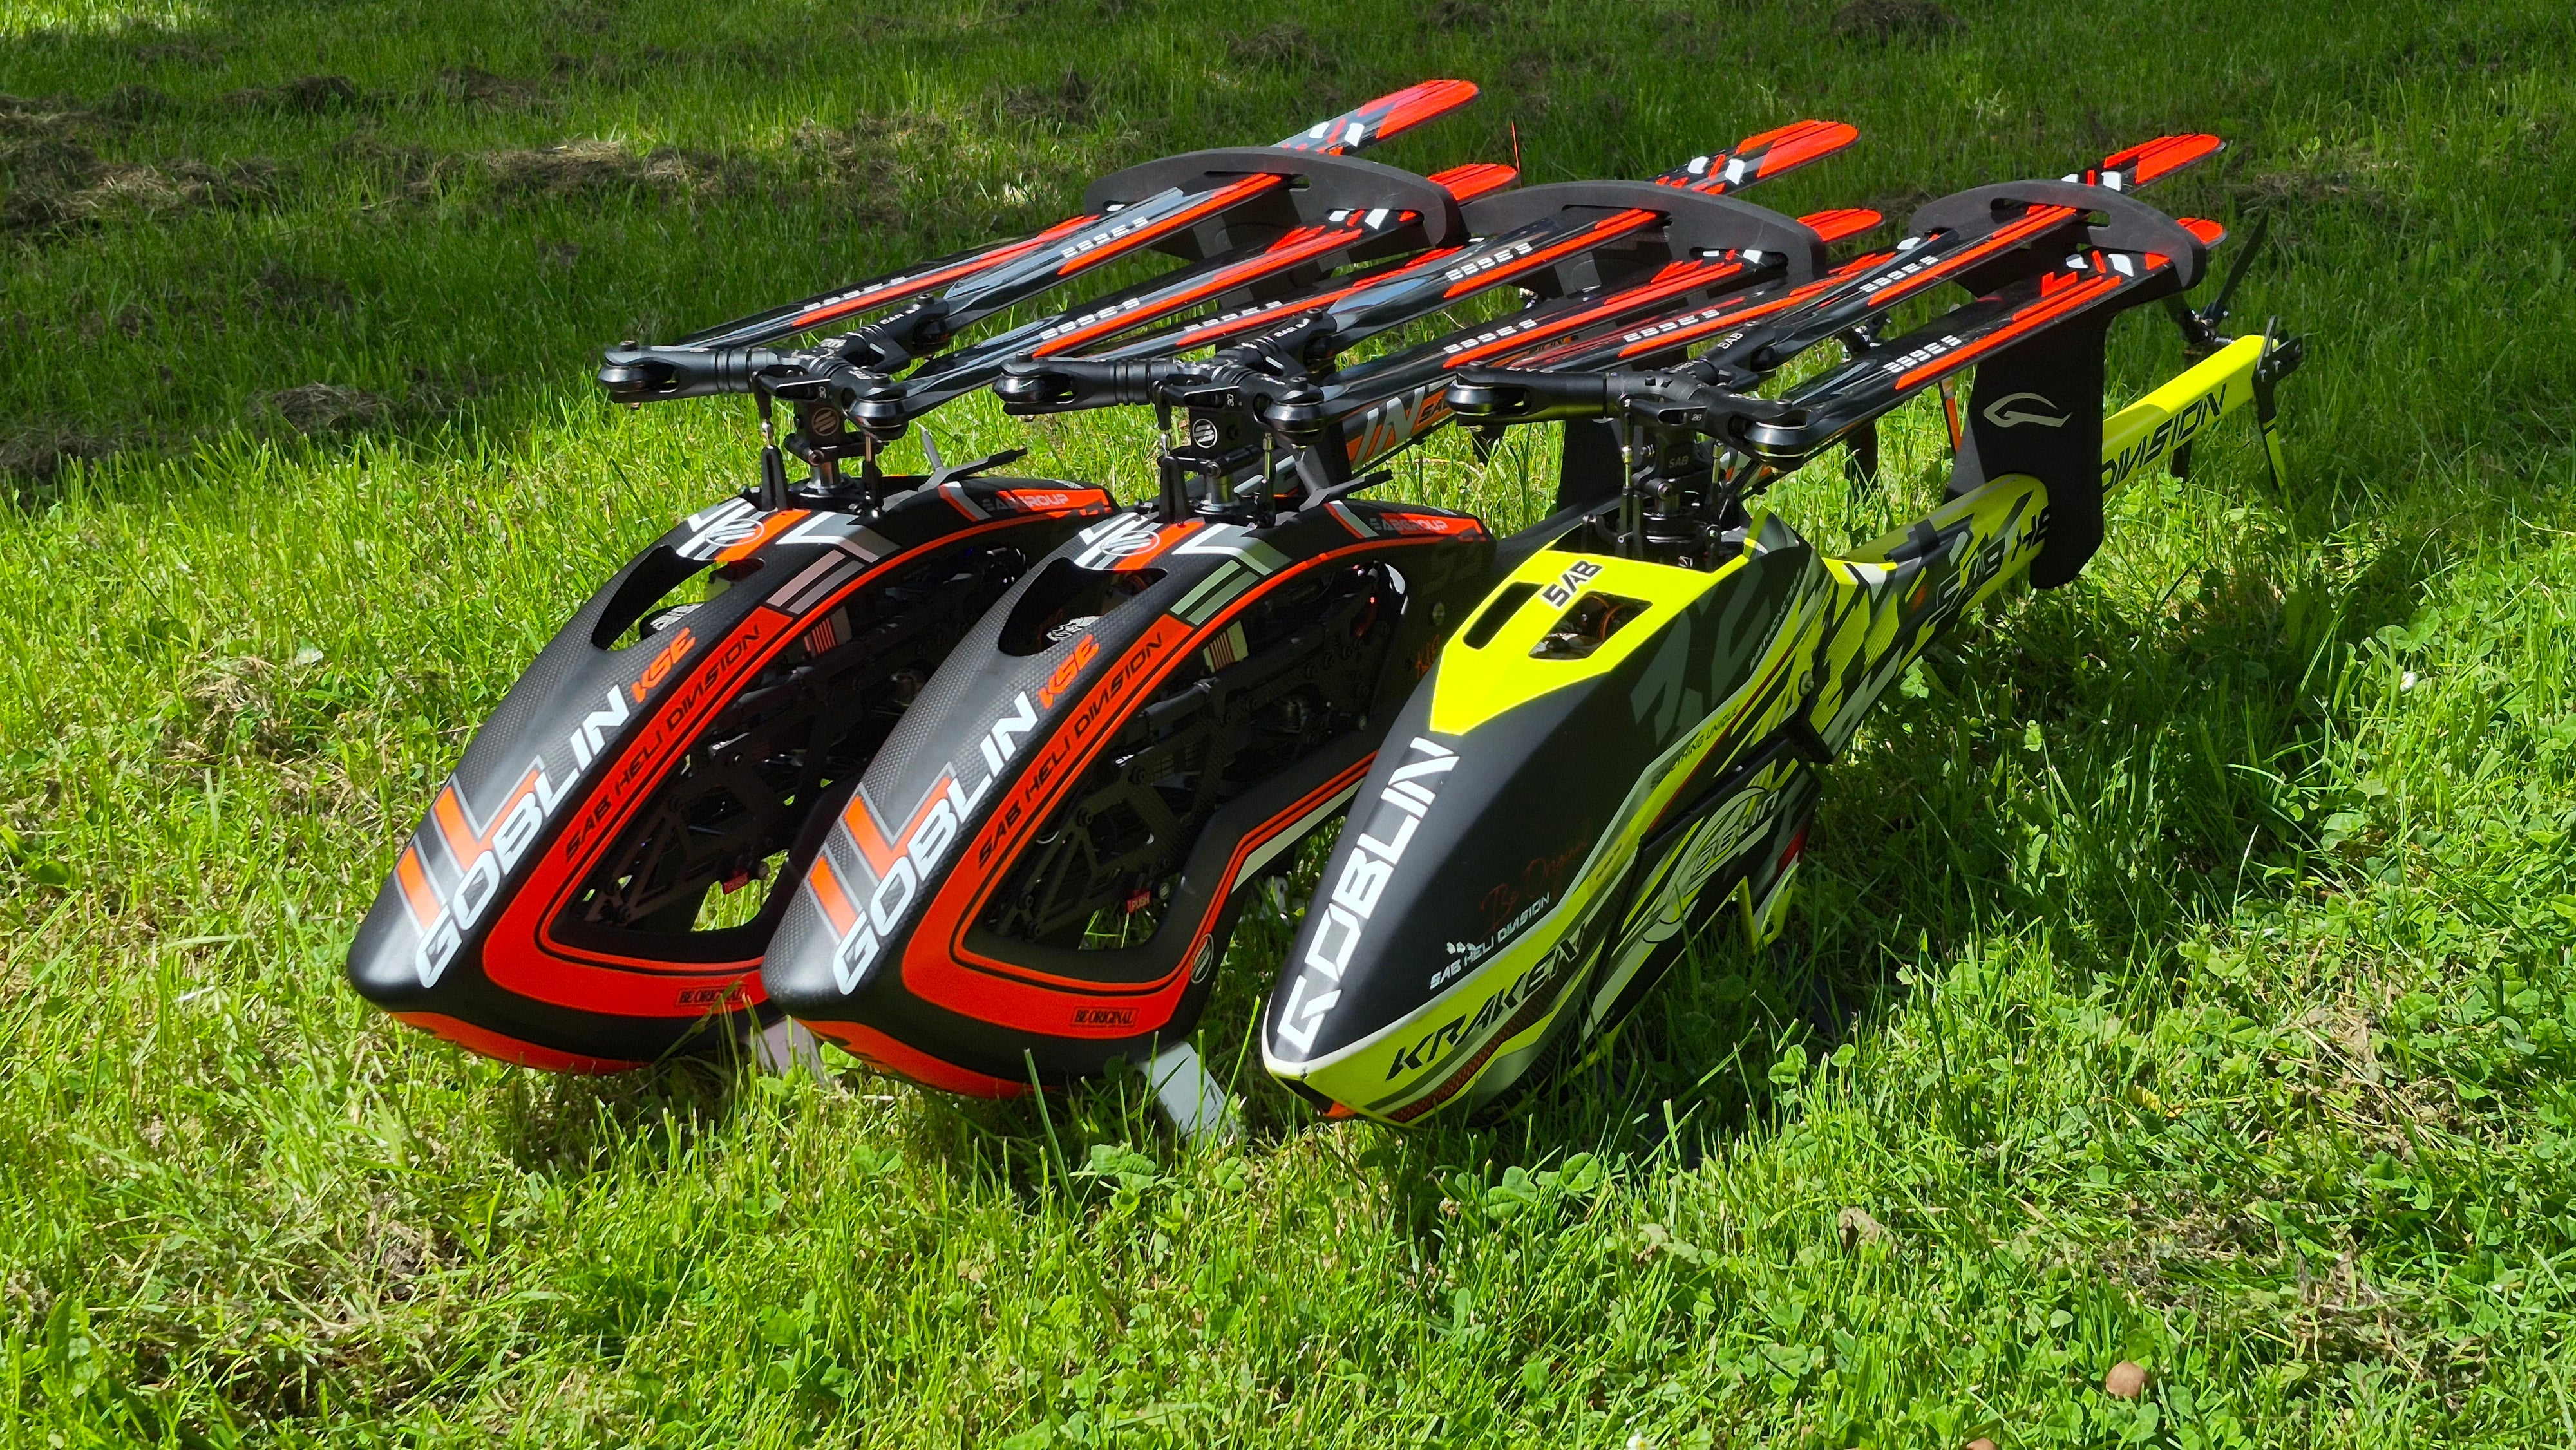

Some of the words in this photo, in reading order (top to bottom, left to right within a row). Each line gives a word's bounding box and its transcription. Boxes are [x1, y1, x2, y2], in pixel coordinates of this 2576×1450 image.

[1717, 332, 1743, 350] SAB
[1227, 393, 1235, 407] 30
[1668, 455, 1689, 469] SAB
[1542, 559, 1604, 608] SAB
[631, 626, 696, 703] KSE
[1038, 634, 1099, 709] KSE
[565, 797, 613, 863] SAB
[614, 730, 663, 796] HELI
[667, 625, 761, 733] DIVISION
[978, 802, 1022, 870] SAB
[1025, 739, 1071, 803] HELI
[1074, 632, 1164, 740] DIVISION
[1650, 733, 1704, 789] SOMETHING
[415, 684, 630, 988] GOBLIN
[833, 690, 1039, 995] GOBLIN
[1132, 895, 1150, 910] PUSH
[1277, 736, 1461, 1055] GOBLIN
[1429, 958, 1462, 990] SAB
[1463, 936, 1495, 967] HELI
[1497, 891, 1551, 944] DIVISION
[1385, 923, 1586, 1082] KRAKEN
